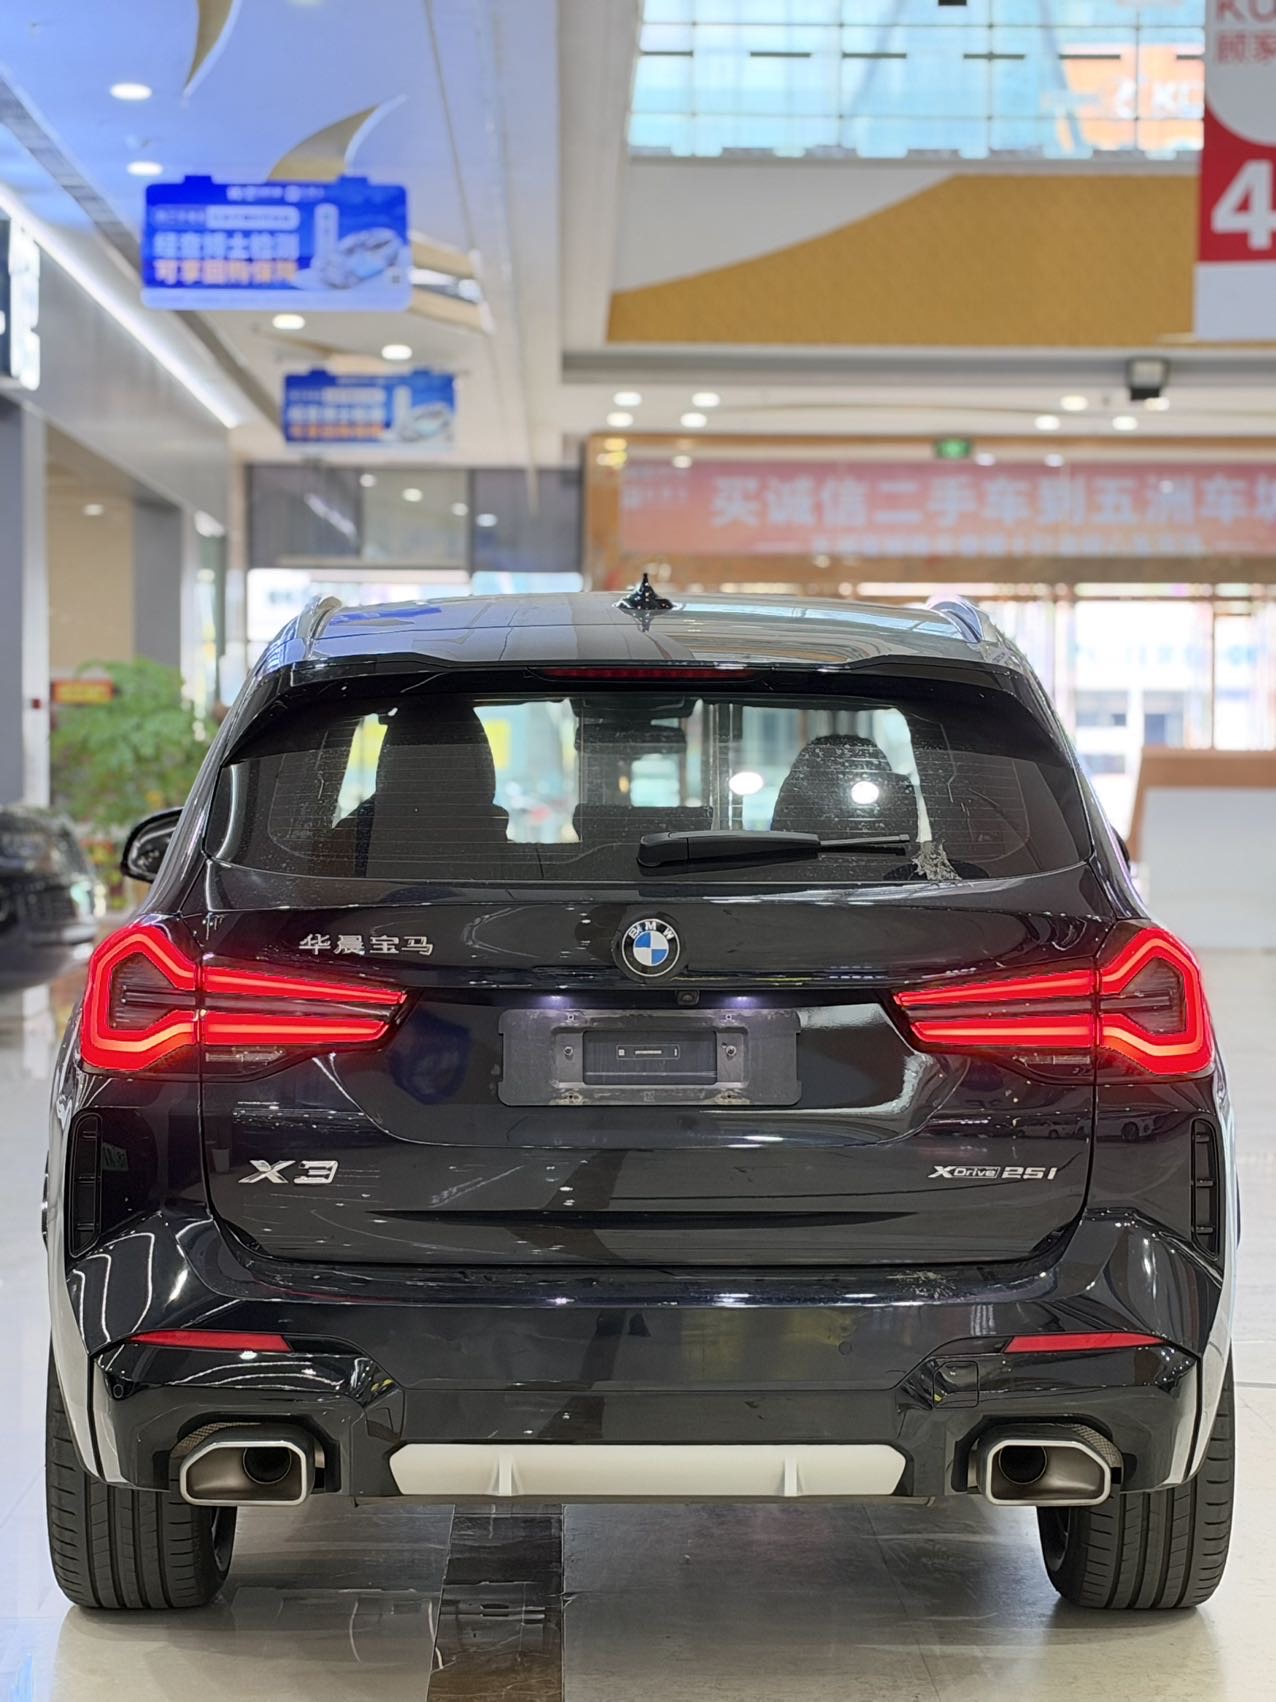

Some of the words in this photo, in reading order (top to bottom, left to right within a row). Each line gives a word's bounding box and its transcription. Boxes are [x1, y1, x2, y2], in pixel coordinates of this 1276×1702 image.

[628, 921, 675, 940] BMW
[299, 934, 434, 955] 华晨宝马
[238, 1160, 338, 1184] X3
